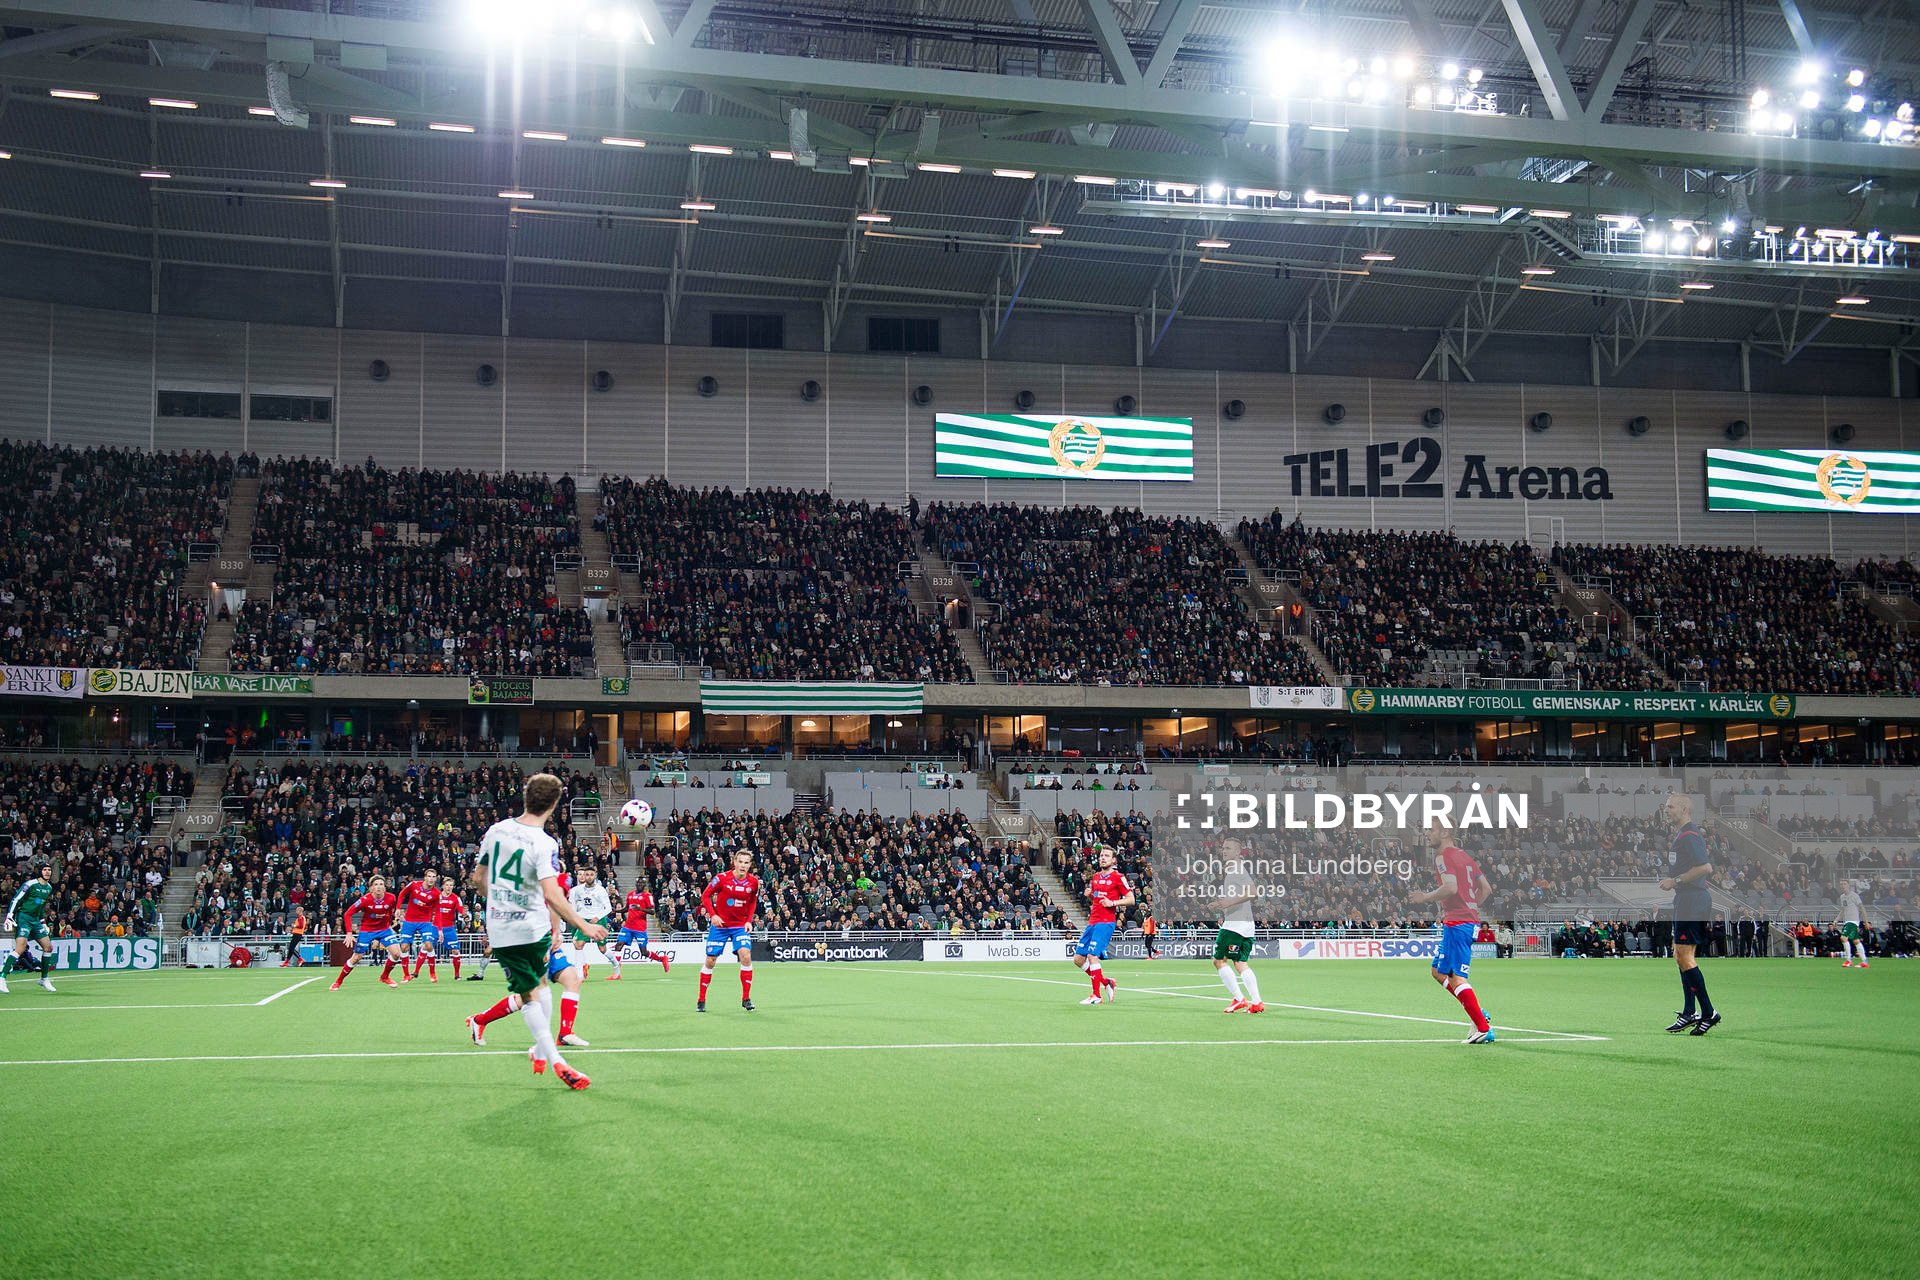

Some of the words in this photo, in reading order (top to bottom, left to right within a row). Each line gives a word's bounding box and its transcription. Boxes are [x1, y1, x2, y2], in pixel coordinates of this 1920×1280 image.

[1283, 437, 1444, 498] TELE2
[1455, 454, 1614, 500] Arena
[220, 560, 243, 570] B330
[587, 569, 609, 578] B329
[933, 577, 953, 586] B328
[5, 667, 56, 681] SANKT
[7, 680, 53, 692] ERIK
[118, 671, 191, 694] BAJEN
[193, 675, 221, 690] HÄR
[262, 677, 300, 692] LIVAT
[1294, 688, 1315, 696] ERIK
[1380, 695, 1464, 709] HAMMARBY
[1468, 695, 1526, 709] FOTBOLL
[1532, 697, 1621, 711] GEMENSKAP
[1633, 698, 1697, 712] RESPEKT
[1708, 696, 1764, 713] KÄRLEK
[185, 814, 214, 825] A130
[1000, 817, 1024, 827] A128
[490, 841, 525, 891] 14
[774, 946, 817, 959] Sefina
[825, 945, 888, 961] pantbank
[988, 944, 1041, 958] lwab.se
[1319, 939, 1440, 958] INTERSPOR
